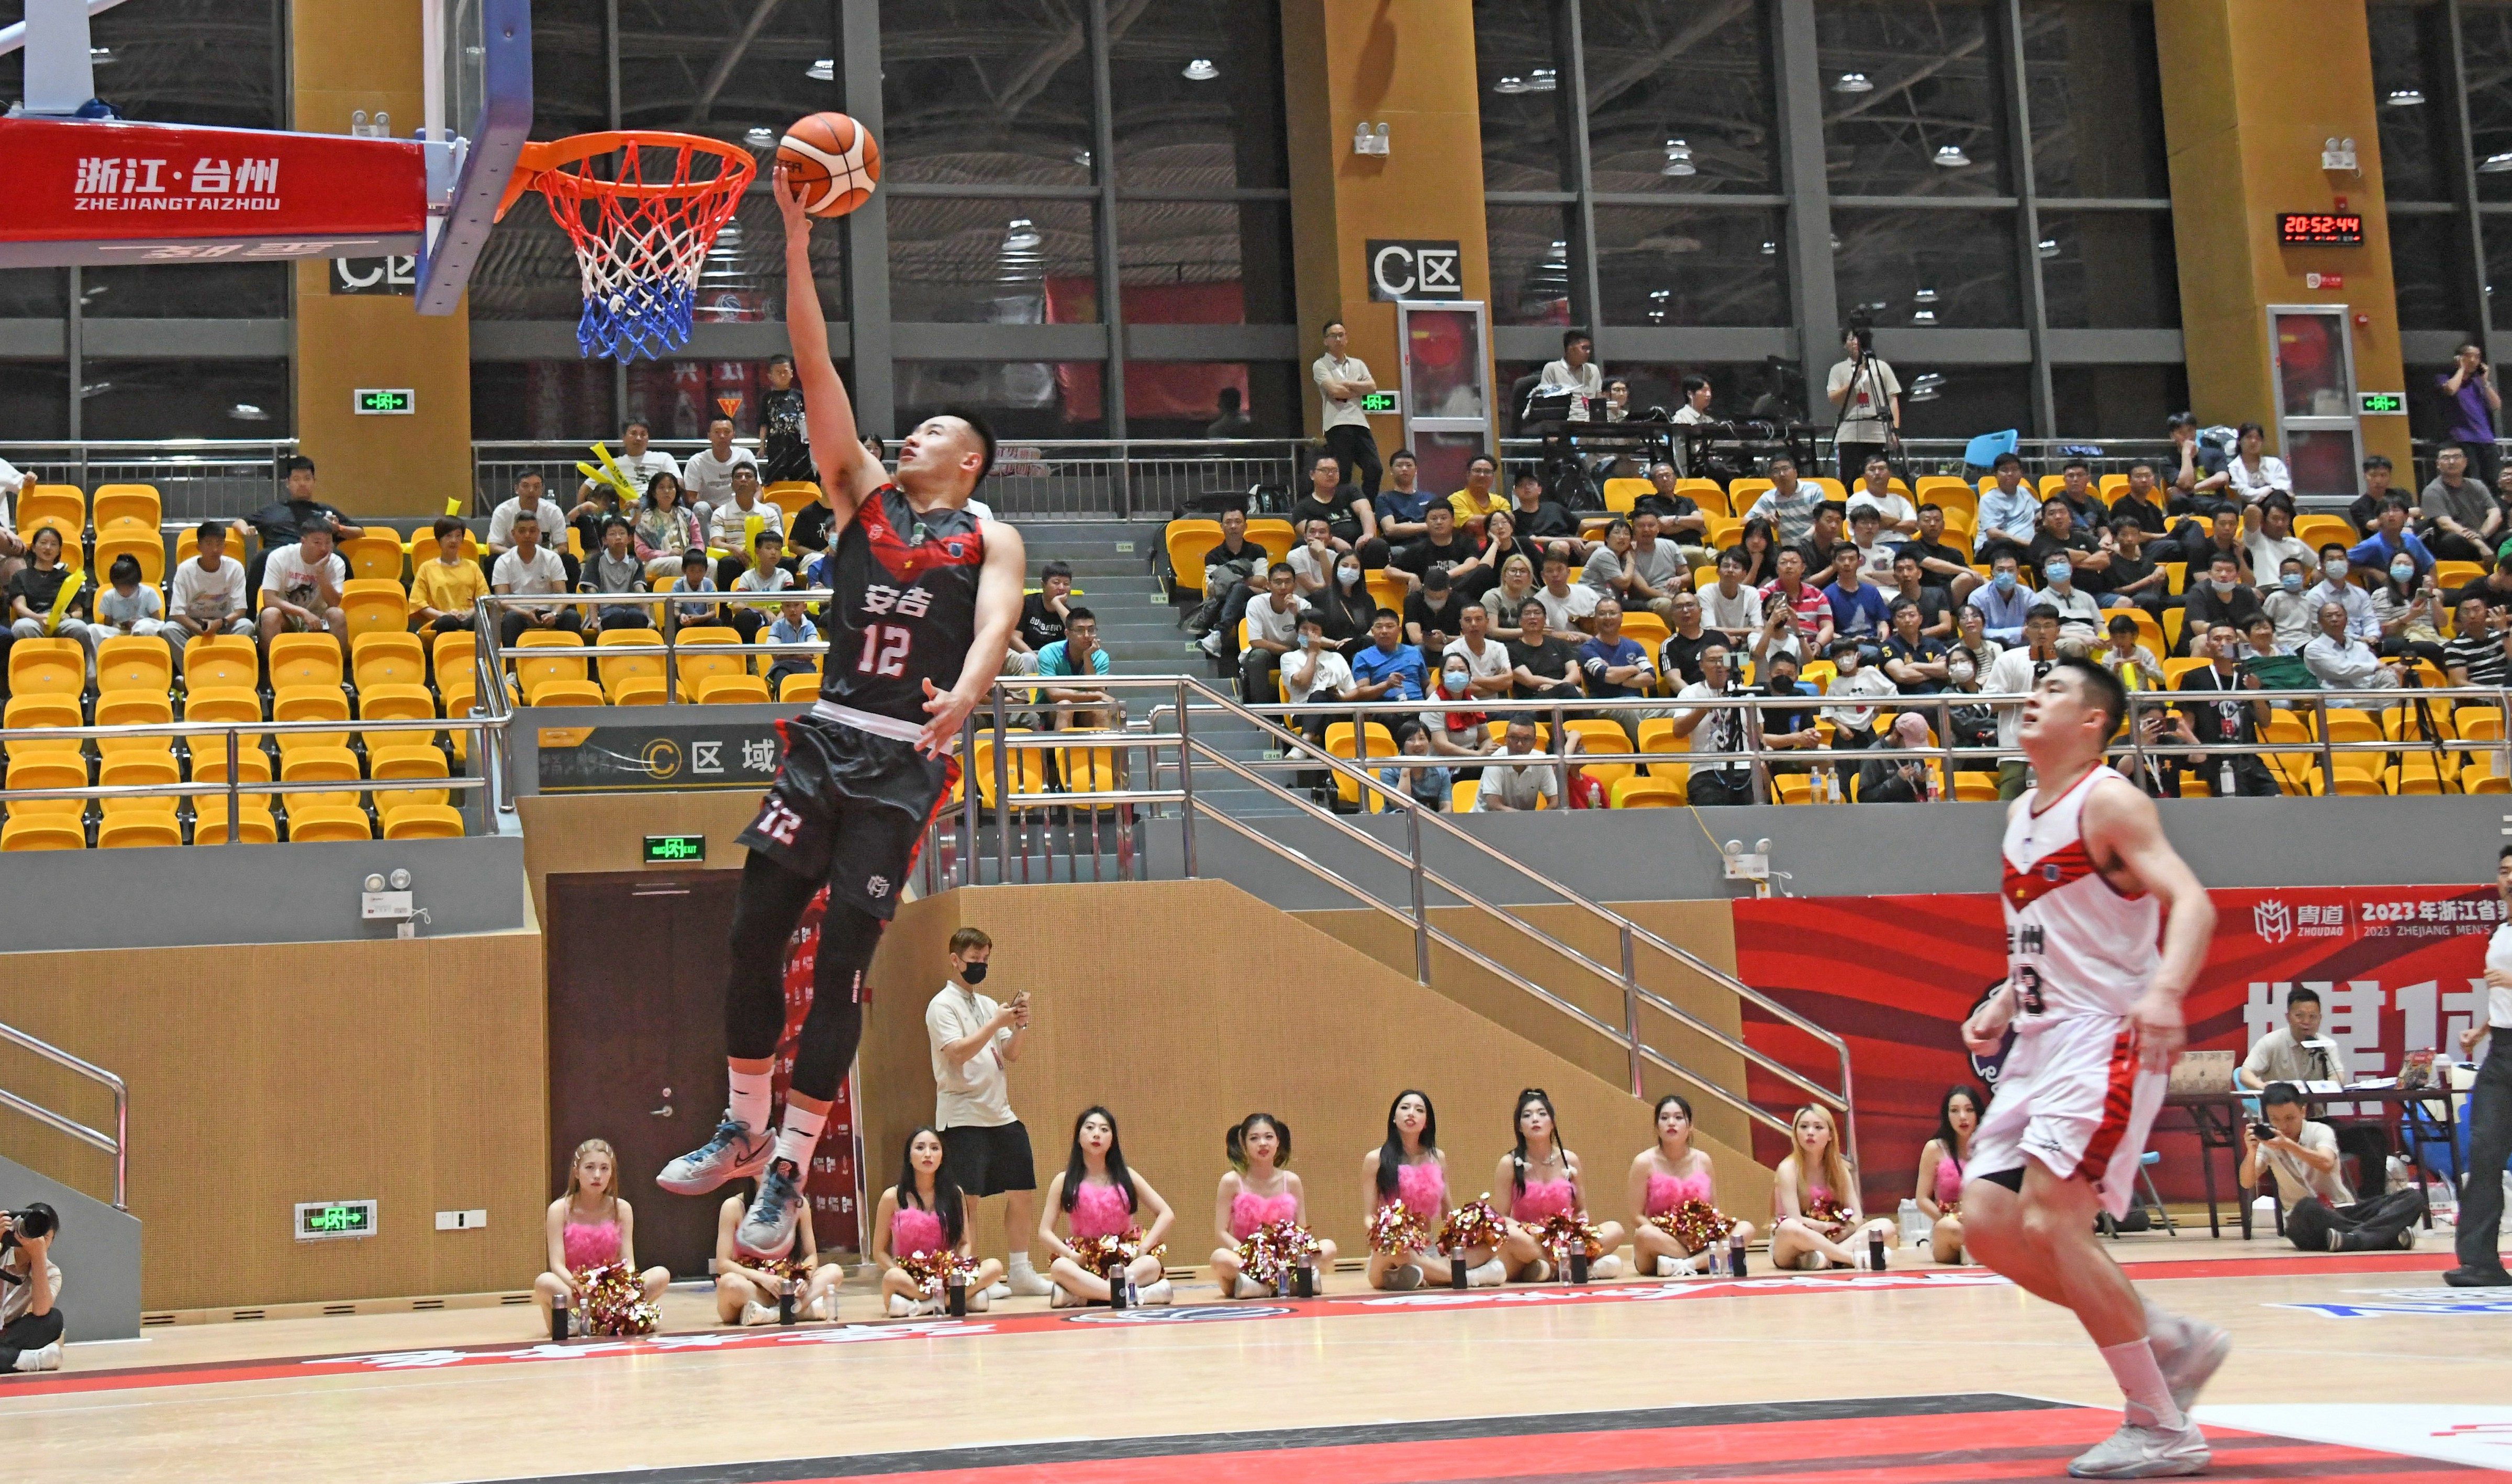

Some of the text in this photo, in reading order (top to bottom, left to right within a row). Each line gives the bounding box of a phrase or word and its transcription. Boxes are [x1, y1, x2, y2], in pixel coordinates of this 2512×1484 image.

[75, 158, 279, 194] 浙江·台州
[75, 198, 280, 210] ZHEJIANGTAIZHOU
[2285, 216, 2359, 233] 20:52:44
[1374, 246, 1460, 295] C区
[861, 585, 933, 618] 安吉
[858, 624, 912, 677] 12
[757, 800, 802, 845] 12
[2297, 927, 2344, 936] ZHOUDAO
[2363, 926, 2390, 936] 2023
[2396, 925, 2450, 938] ZHEJIANG
